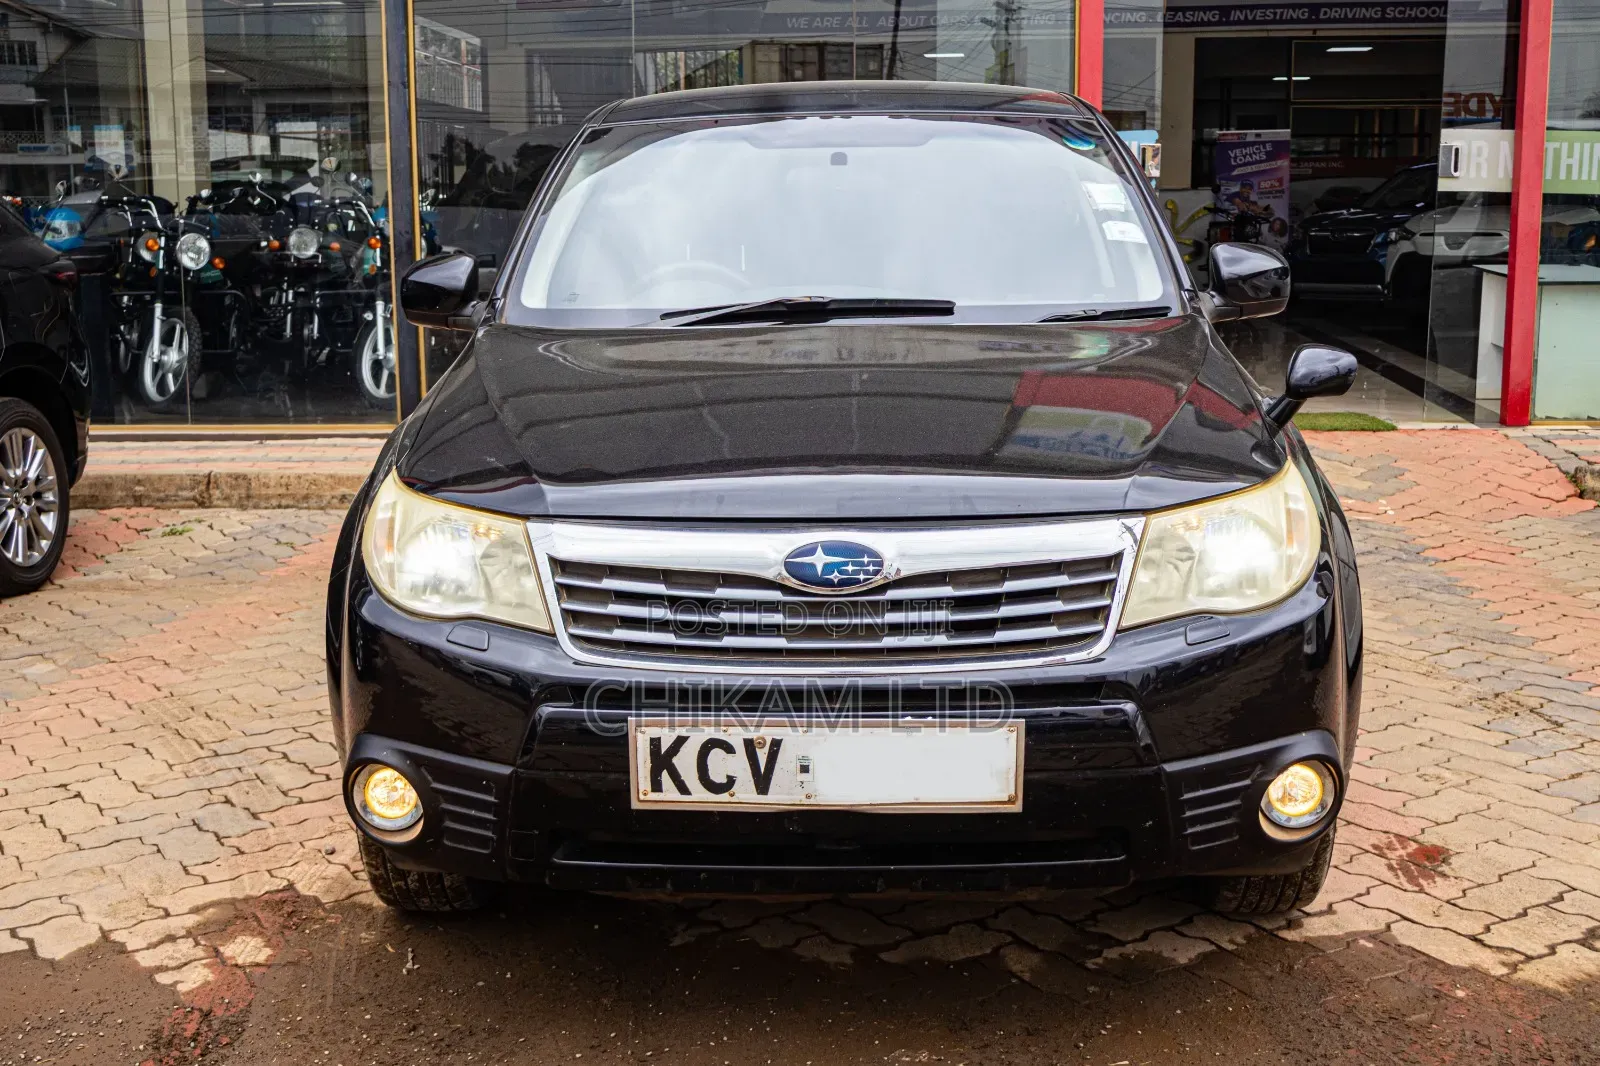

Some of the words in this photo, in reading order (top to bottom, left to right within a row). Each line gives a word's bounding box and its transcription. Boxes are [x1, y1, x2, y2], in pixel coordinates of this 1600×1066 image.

[786, 17, 809, 29] WE
[812, 16, 842, 28] ARE
[845, 16, 869, 28] ALL
[876, 15, 927, 28] ABOUT
[1156, 10, 1220, 23] LEASING
[1230, 8, 1309, 21] INVESTING
[1319, 6, 1382, 20] DRIVING
[1384, 6, 1448, 19] SCHOOL
[1228, 142, 1273, 158] VEHICLE
[1230, 153, 1267, 166] LOANS
[648, 735, 784, 796] KCV
